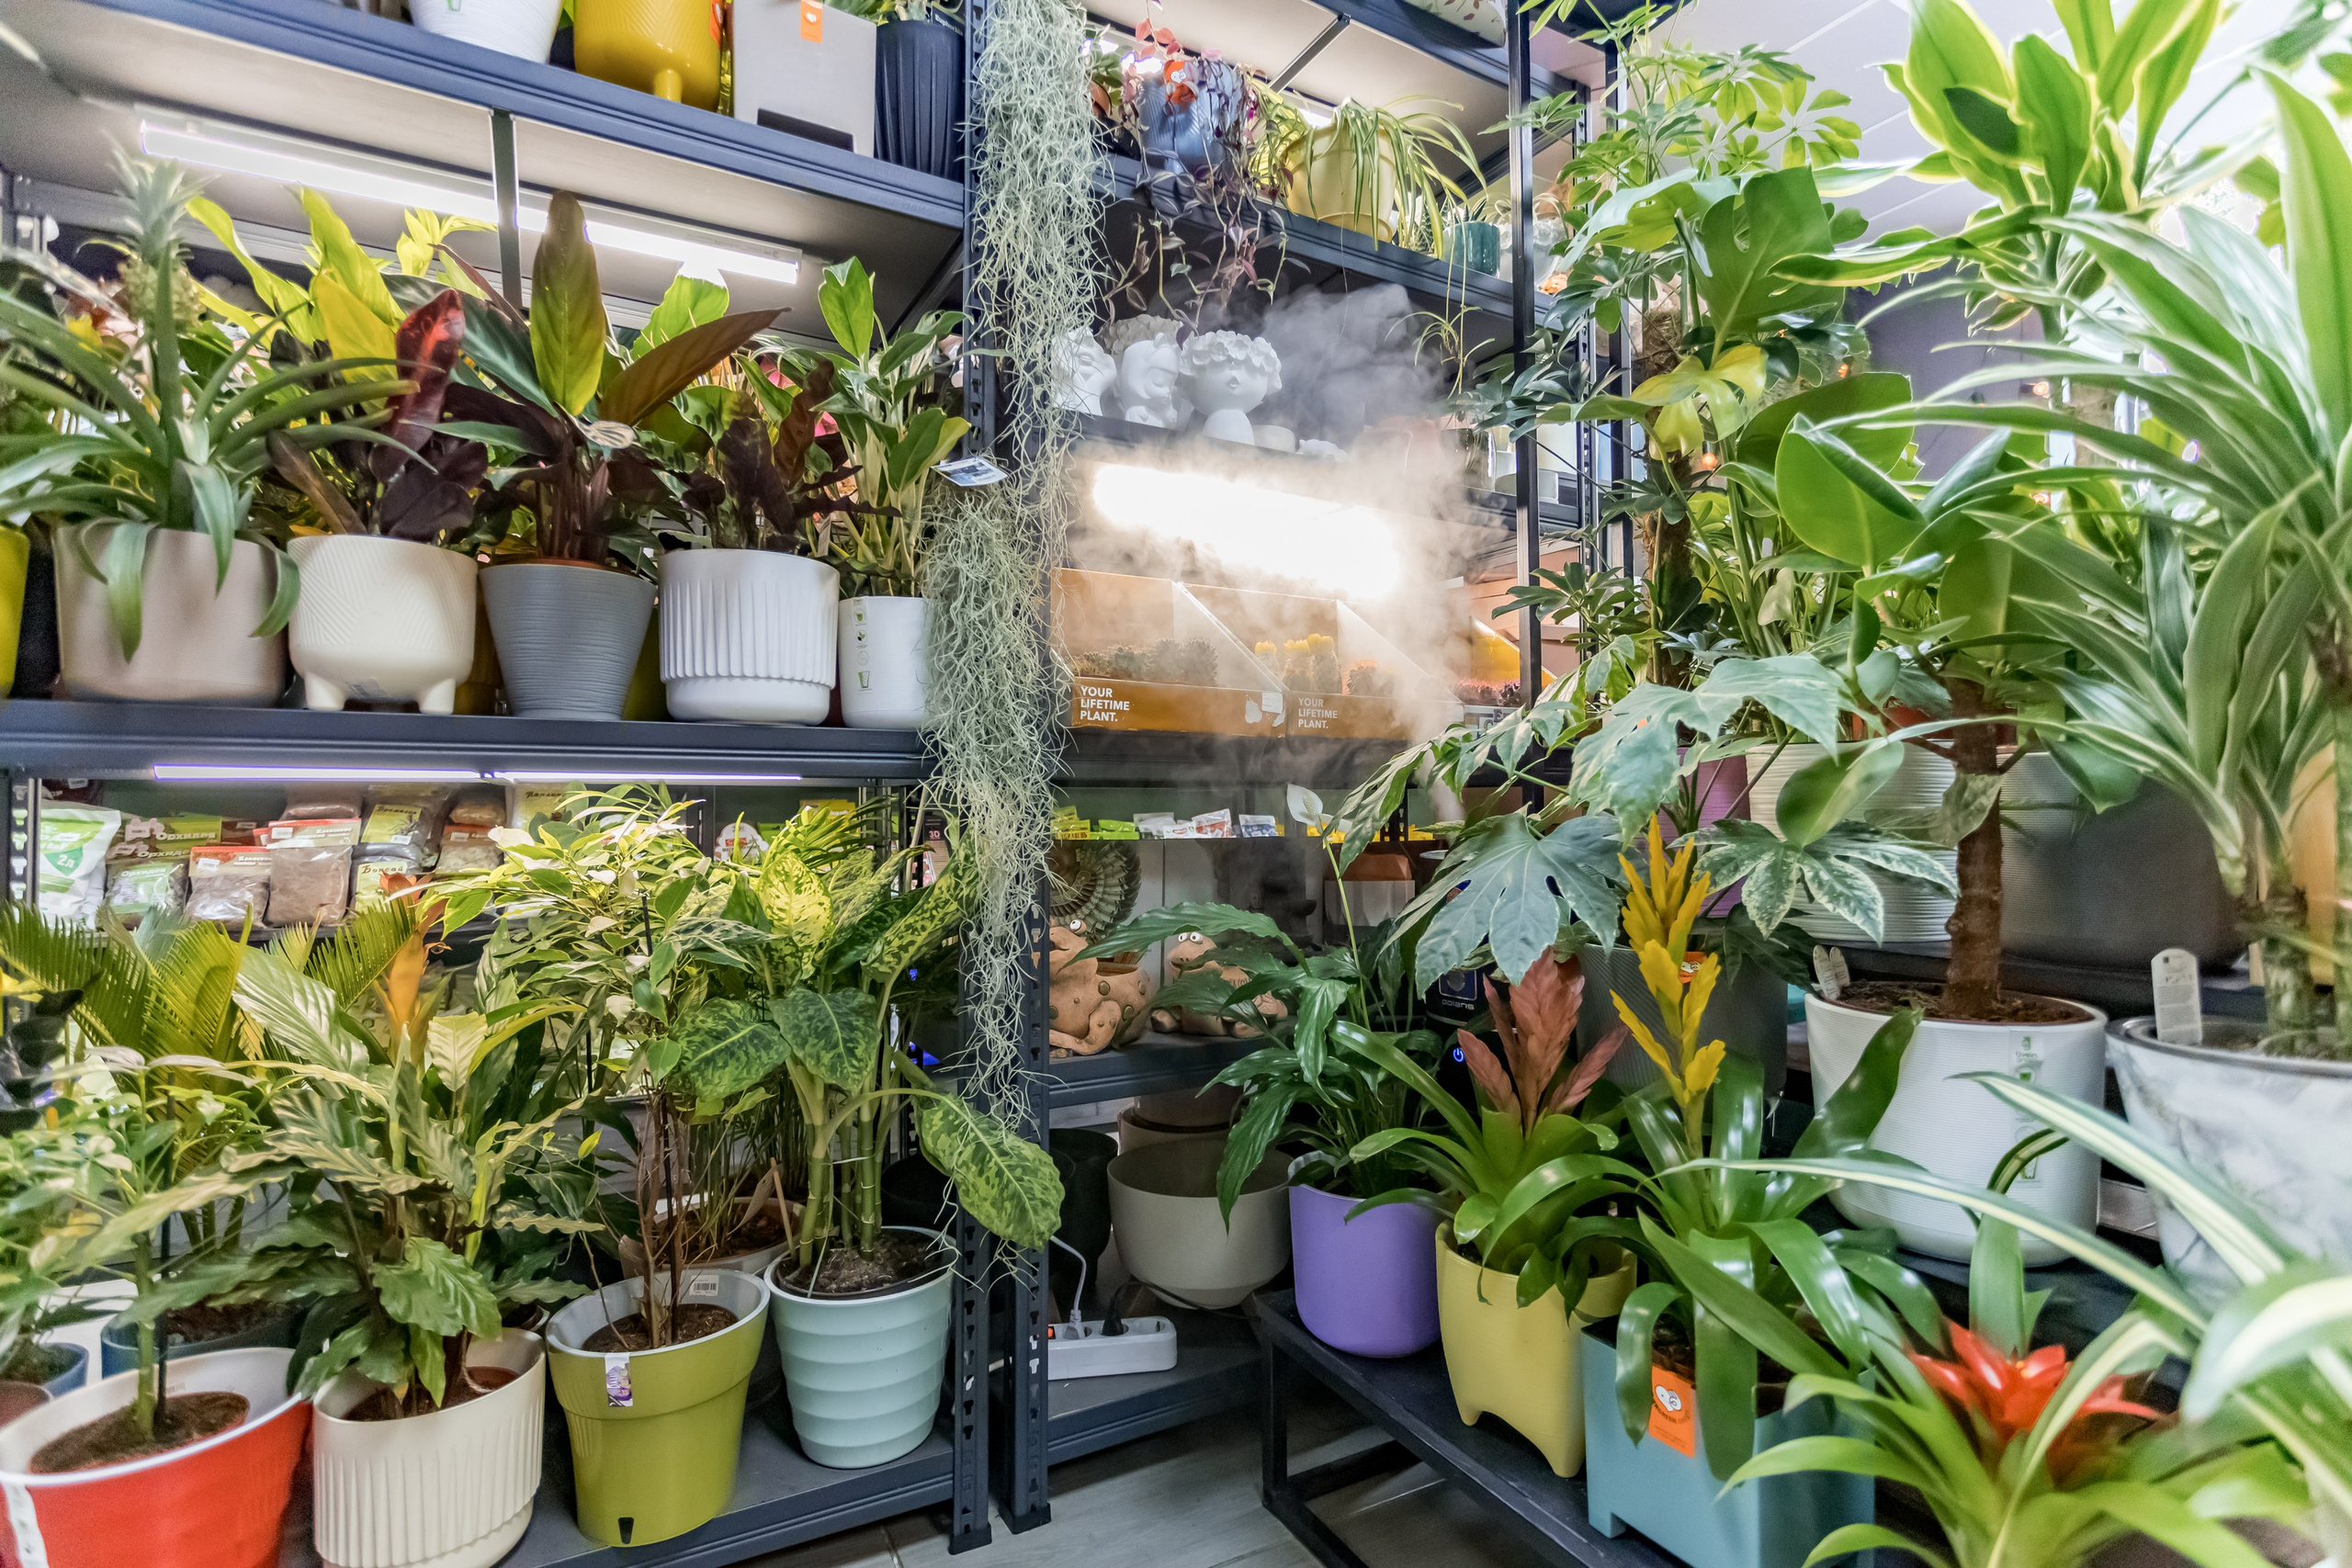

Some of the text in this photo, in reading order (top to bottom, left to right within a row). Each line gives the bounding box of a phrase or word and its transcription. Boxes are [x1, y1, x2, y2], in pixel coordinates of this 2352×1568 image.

[1080, 685, 1114, 698] YOUR
[1080, 698, 1130, 711] LIFETIME
[1297, 697, 1324, 707] YOUR
[1080, 710, 1118, 722] PLANT.
[1298, 708, 1338, 719] LIFETIME
[1298, 718, 1329, 728] PLANT.
[155, 831, 216, 840] Орхидея
[137, 850, 190, 859] Орхиде
[57, 854, 75, 868] 2л
[361, 864, 404, 874] Бонсай
[1442, 998, 1475, 1010] polaris
